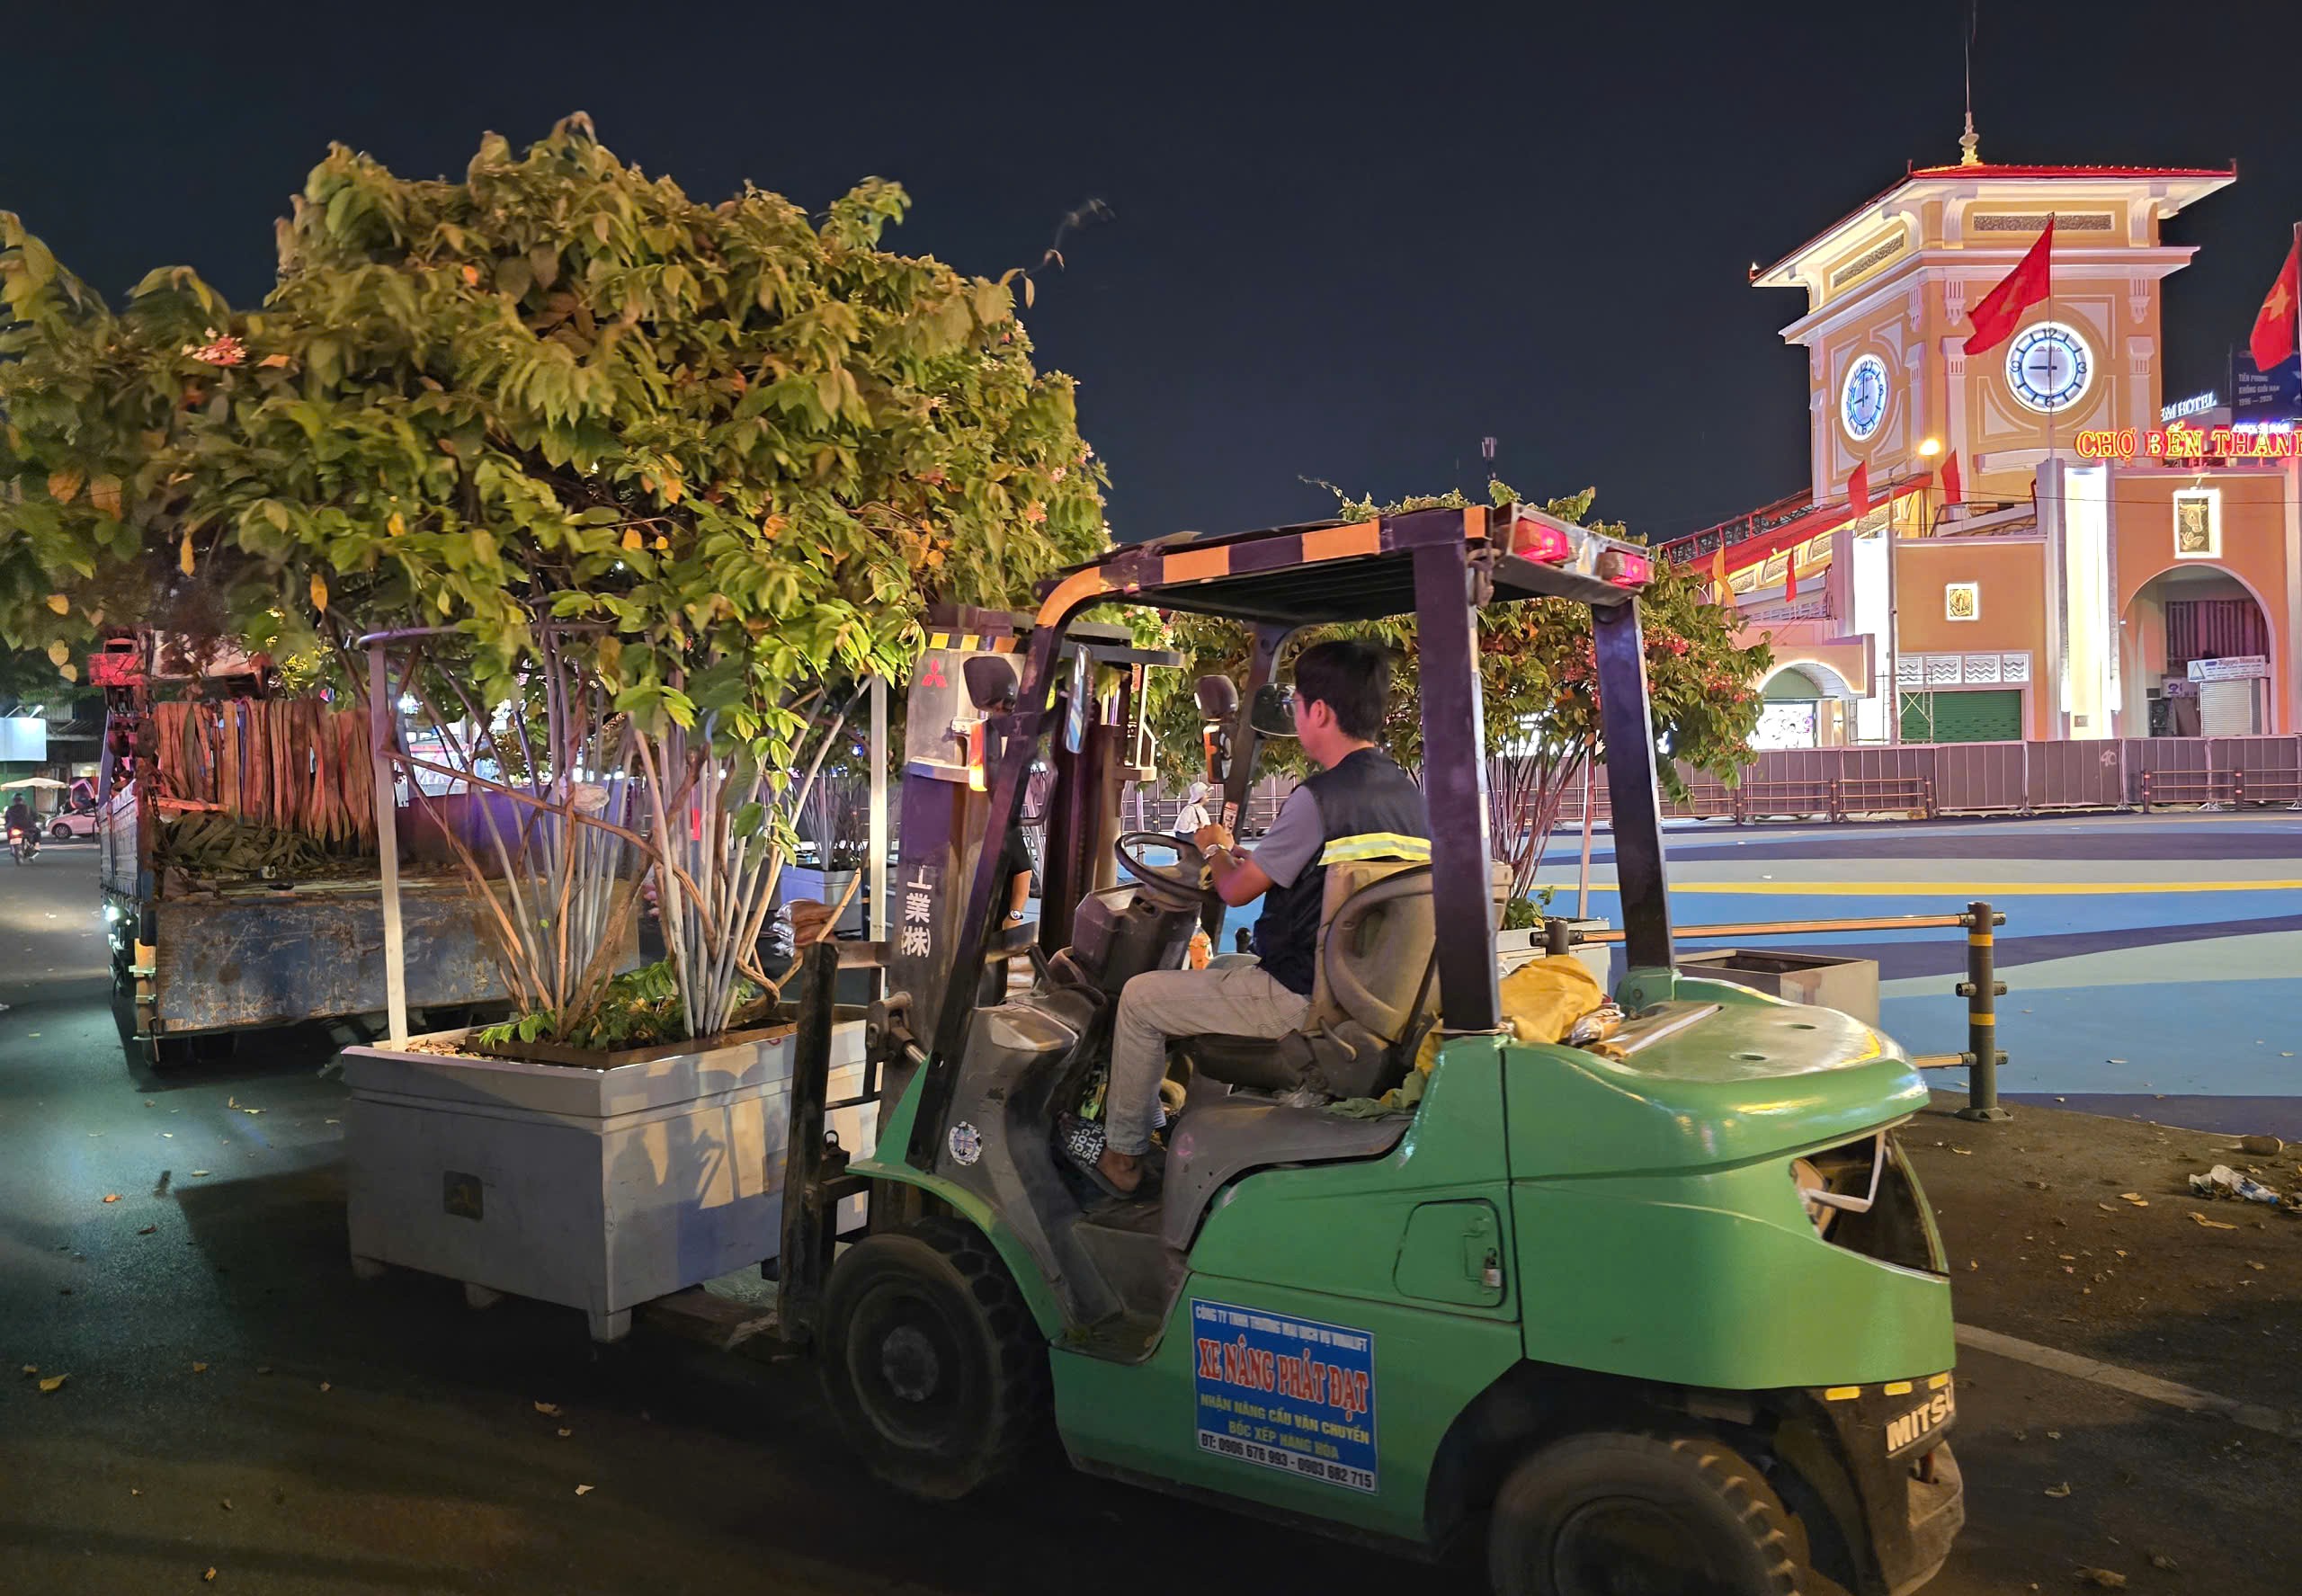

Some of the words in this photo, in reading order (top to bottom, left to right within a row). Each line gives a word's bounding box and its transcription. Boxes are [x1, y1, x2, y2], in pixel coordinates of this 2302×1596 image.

[2077, 361, 2087, 374] 3
[2177, 392, 2217, 416] HOTEL
[2074, 426, 2137, 462] CHỢ
[2145, 420, 2205, 458] BẾN
[1197, 1338, 1221, 1381] XE
[1223, 1333, 1275, 1393] NÂNG
[1277, 1349, 1326, 1404] PHÁT
[1327, 1365, 1369, 1422] ĐẠT
[1351, 1471, 1372, 1488] 715
